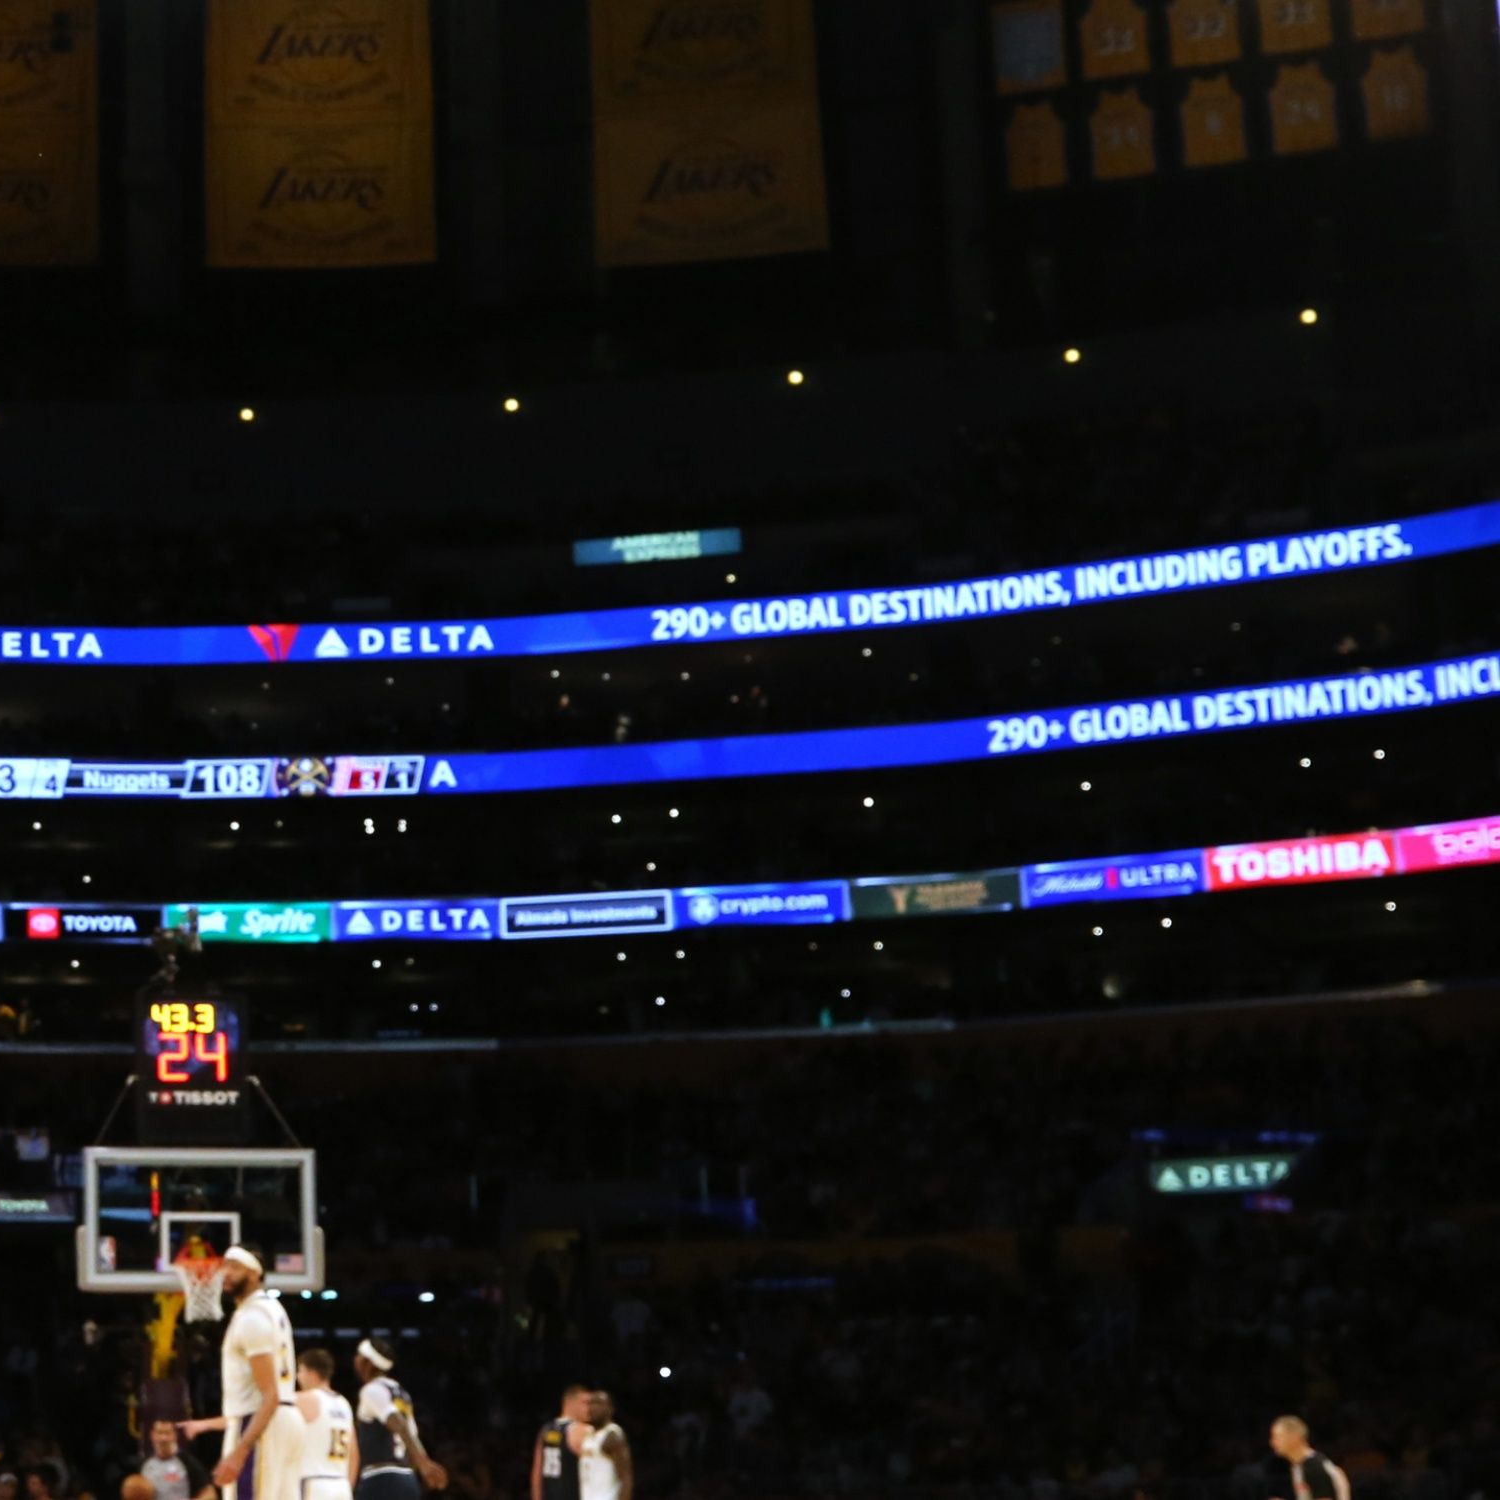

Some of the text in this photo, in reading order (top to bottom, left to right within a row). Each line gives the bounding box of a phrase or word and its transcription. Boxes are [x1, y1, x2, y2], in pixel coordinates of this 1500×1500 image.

[651, 523, 1413, 640] 290+ GLOBAL DESTINATIONS, INCLUDING PLAYOFFS.
[358, 625, 495, 653] DELTA
[987, 715, 1064, 753] 290+
[1068, 699, 1191, 743] GLOBAL
[1192, 670, 1433, 729] DESTINATIONS,
[43, 774, 59, 794] 4
[83, 769, 171, 791] Nuggets
[199, 765, 261, 795] 108
[1119, 862, 1198, 888] ULTRA
[1212, 839, 1391, 883] TOSHIBA
[380, 908, 491, 931] DELTA
[719, 894, 829, 916] crypto.com
[62, 915, 138, 932] TOYOTA
[239, 907, 316, 938] Sprite
[150, 1003, 215, 1034] 43.3
[157, 1032, 228, 1083] 24
[173, 1090, 239, 1105] TISSOT
[327, 1427, 350, 1461] 15
